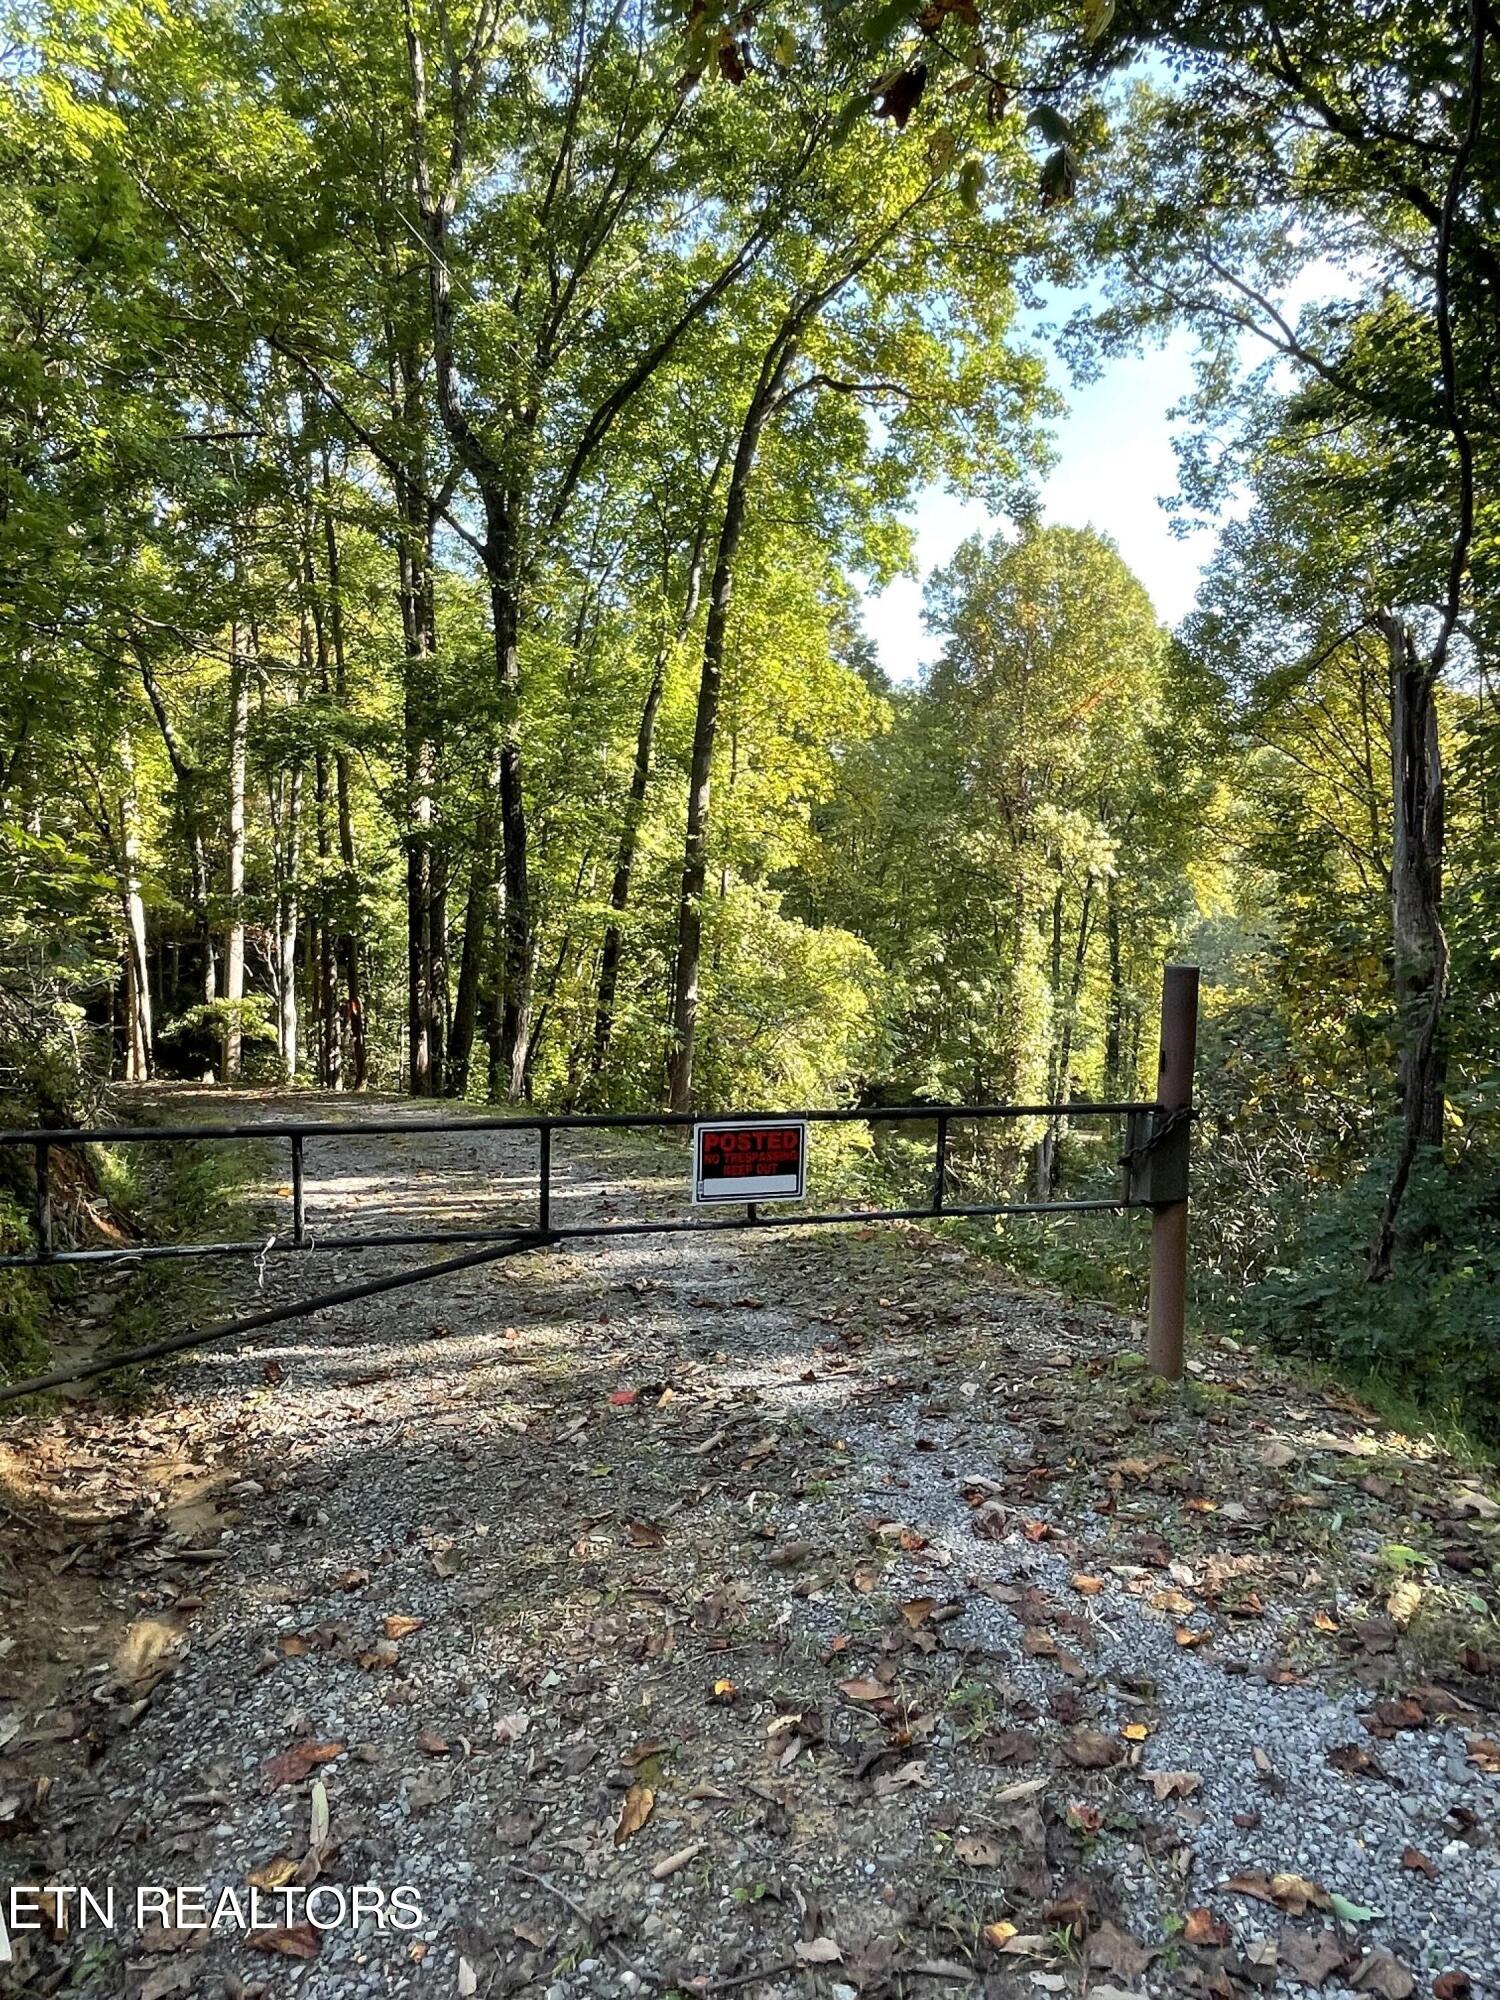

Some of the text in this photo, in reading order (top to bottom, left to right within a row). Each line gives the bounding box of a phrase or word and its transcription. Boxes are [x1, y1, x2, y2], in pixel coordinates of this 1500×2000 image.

[704, 1131, 798, 1152] POSTED
[704, 1151, 798, 1164] NO TRESPASSING
[724, 1163, 778, 1175] KEEP OUT
